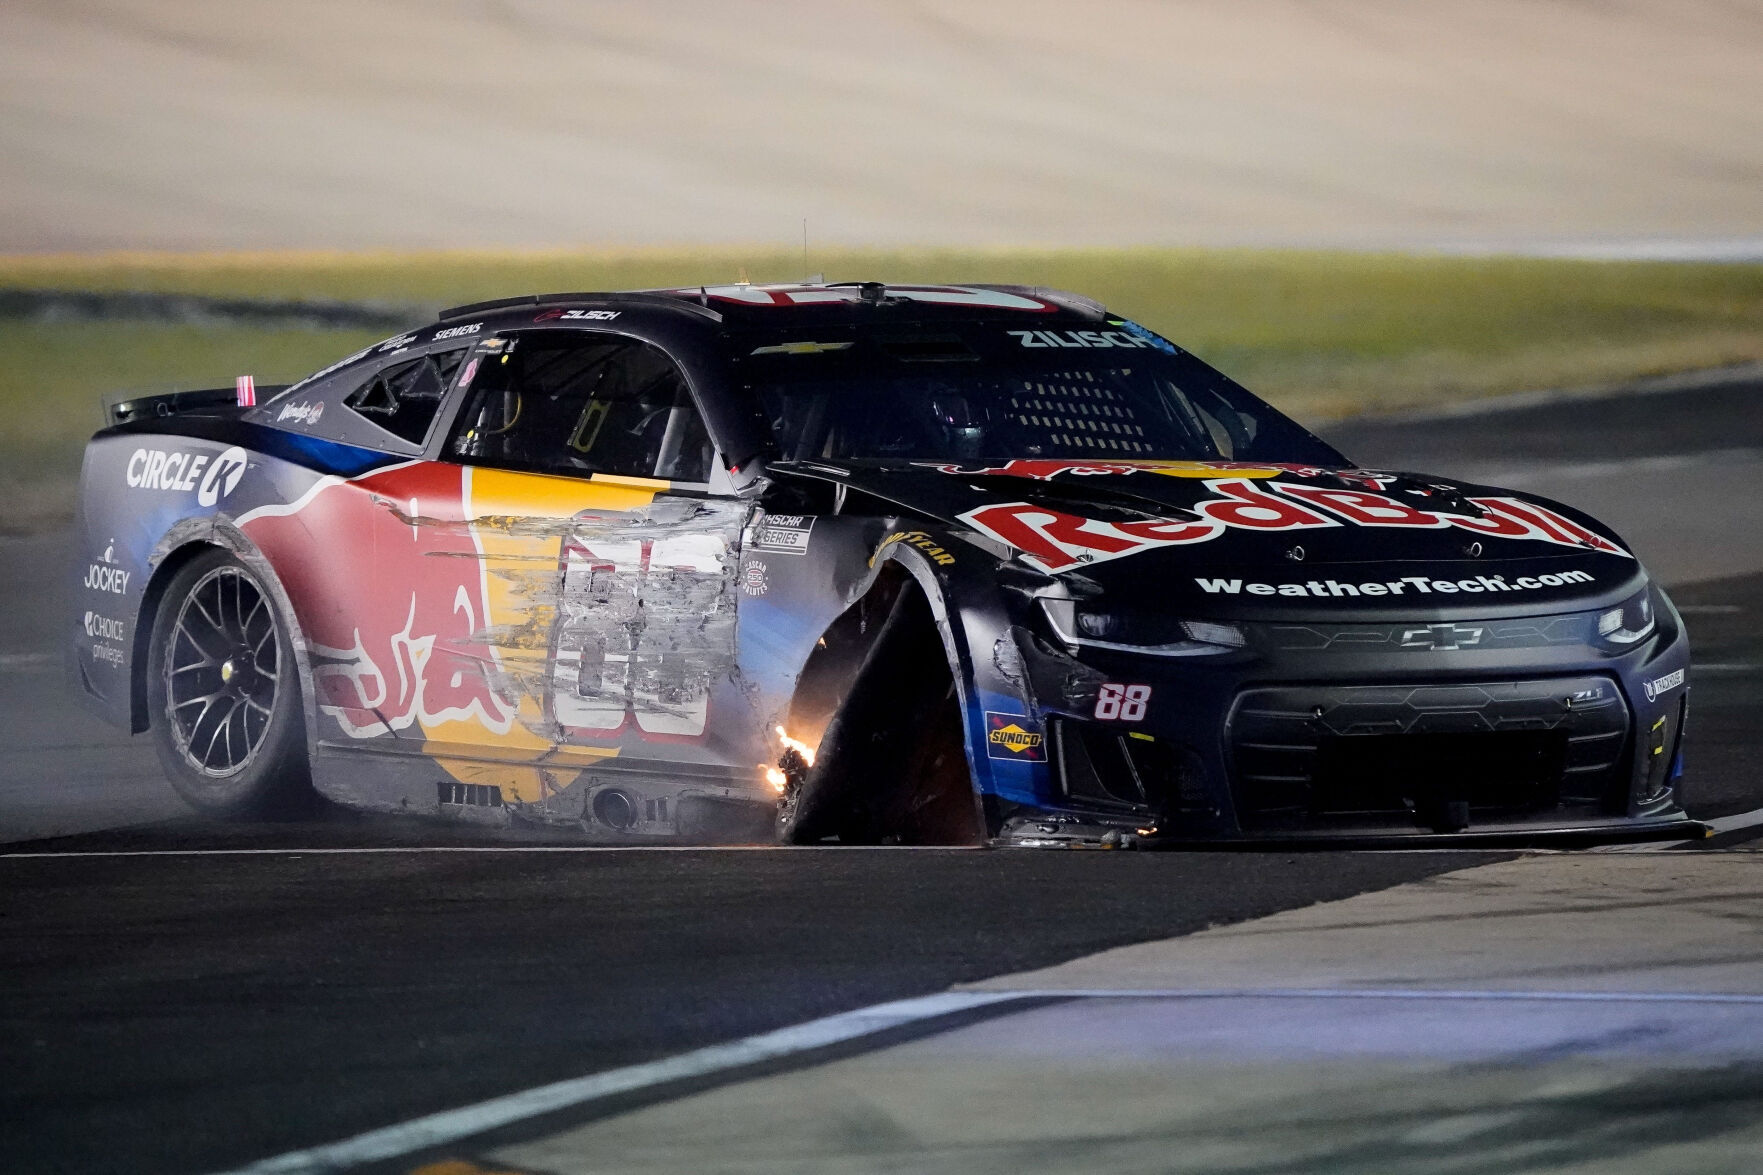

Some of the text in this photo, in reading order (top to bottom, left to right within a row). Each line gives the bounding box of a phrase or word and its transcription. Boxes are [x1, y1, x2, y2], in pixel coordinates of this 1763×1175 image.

[560, 310, 622, 321] ZILISCH
[432, 322, 484, 341] SIEMENS
[1007, 330, 1162, 349] ZILISCH
[126, 448, 244, 507] CIRCLE K
[763, 514, 804, 527] ASCAR
[954, 477, 1338, 576] Red
[763, 530, 799, 545] SERIES
[84, 564, 130, 595] JOCKEY
[93, 614, 124, 641] CHOICE
[1094, 683, 1152, 722] 88
[992, 731, 1039, 746] SUNOCO
